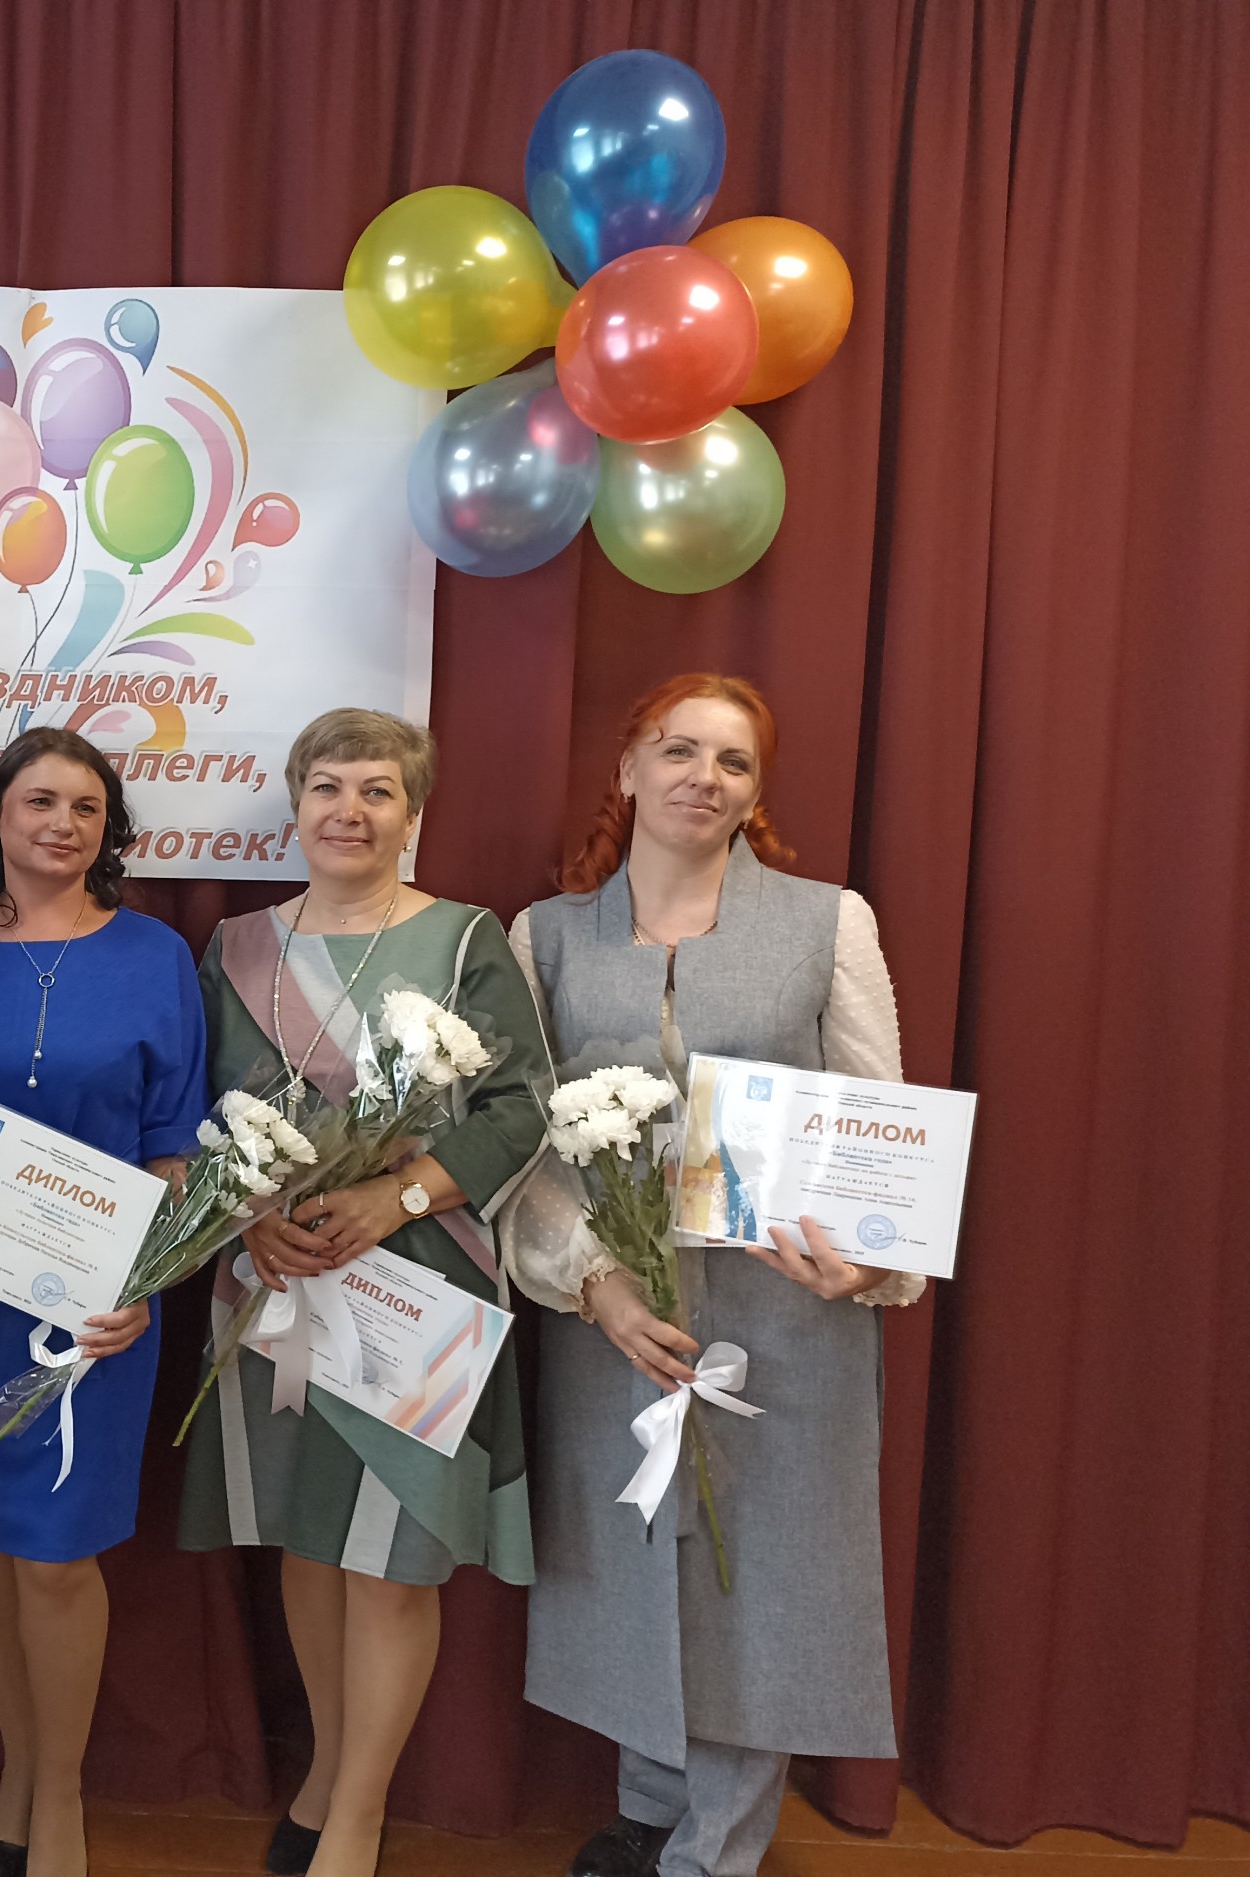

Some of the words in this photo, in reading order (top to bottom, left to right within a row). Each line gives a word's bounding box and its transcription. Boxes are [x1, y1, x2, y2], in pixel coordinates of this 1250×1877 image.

[102, 752, 268, 793] ллеги,
[122, 823, 295, 862] иотек!
[803, 1112, 927, 1146] ДИПЛОМ
[16, 1163, 117, 1217] ДИПЛОМ
[340, 1271, 423, 1322] ДИПЛОМ
